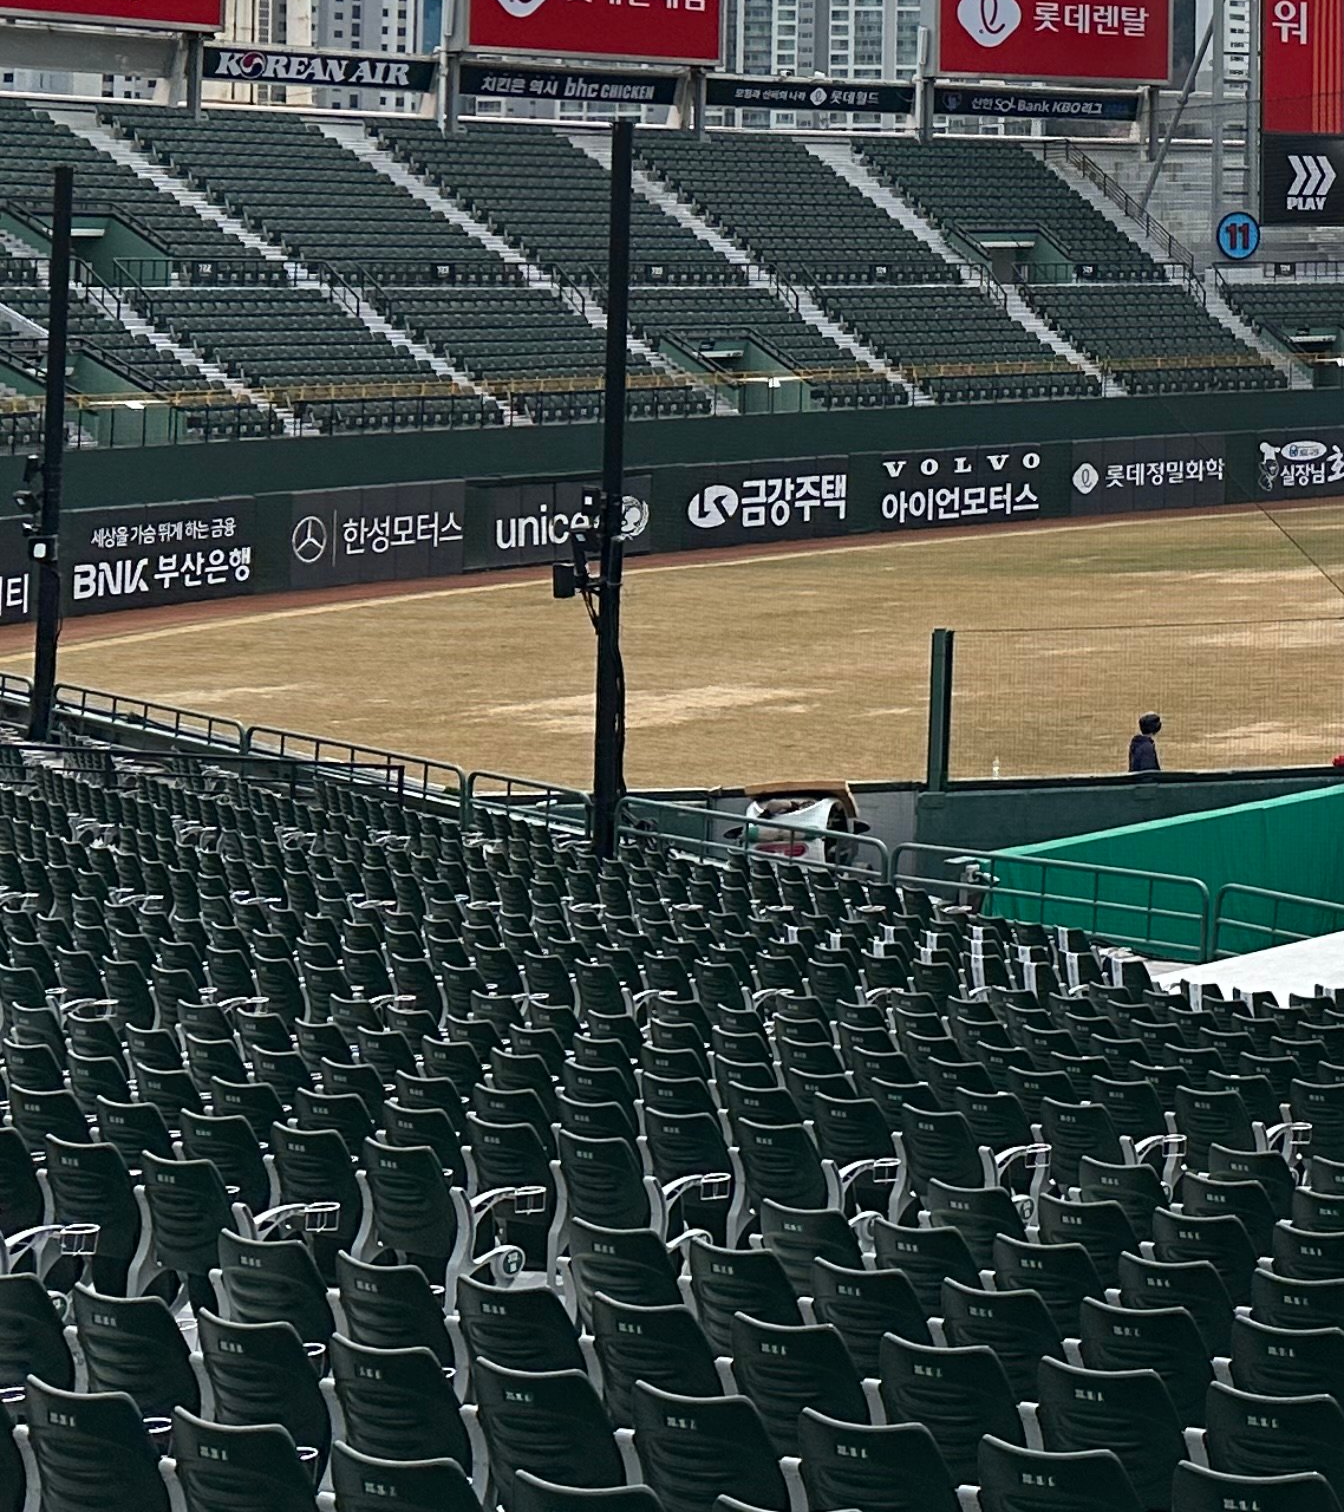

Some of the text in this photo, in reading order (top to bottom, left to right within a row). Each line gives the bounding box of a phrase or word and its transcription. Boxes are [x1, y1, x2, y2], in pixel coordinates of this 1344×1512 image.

[1033, 1, 1149, 38] 롯데렌탈
[213, 51, 410, 87] KOREAN AIR
[481, 75, 655, 100] 치킨은 역시 bhc CHICKEN
[830, 90, 879, 106] 롯데월드
[972, 96, 1049, 113] 신한 Bank
[1287, 196, 1327, 210] PLAY
[1226, 223, 1249, 249] 11
[883, 451, 1040, 478] VOLVO
[1104, 457, 1225, 489] 롯데정밀화학
[1280, 462, 1325, 486] 실장님
[741, 473, 848, 529] 금강주택
[881, 482, 1040, 523] 아이언모터스
[90, 517, 236, 546] 세상을 가슴 뛰게 하는 금융
[342, 511, 463, 555] 한성모터스
[73, 546, 251, 600] BNK 부산은행
